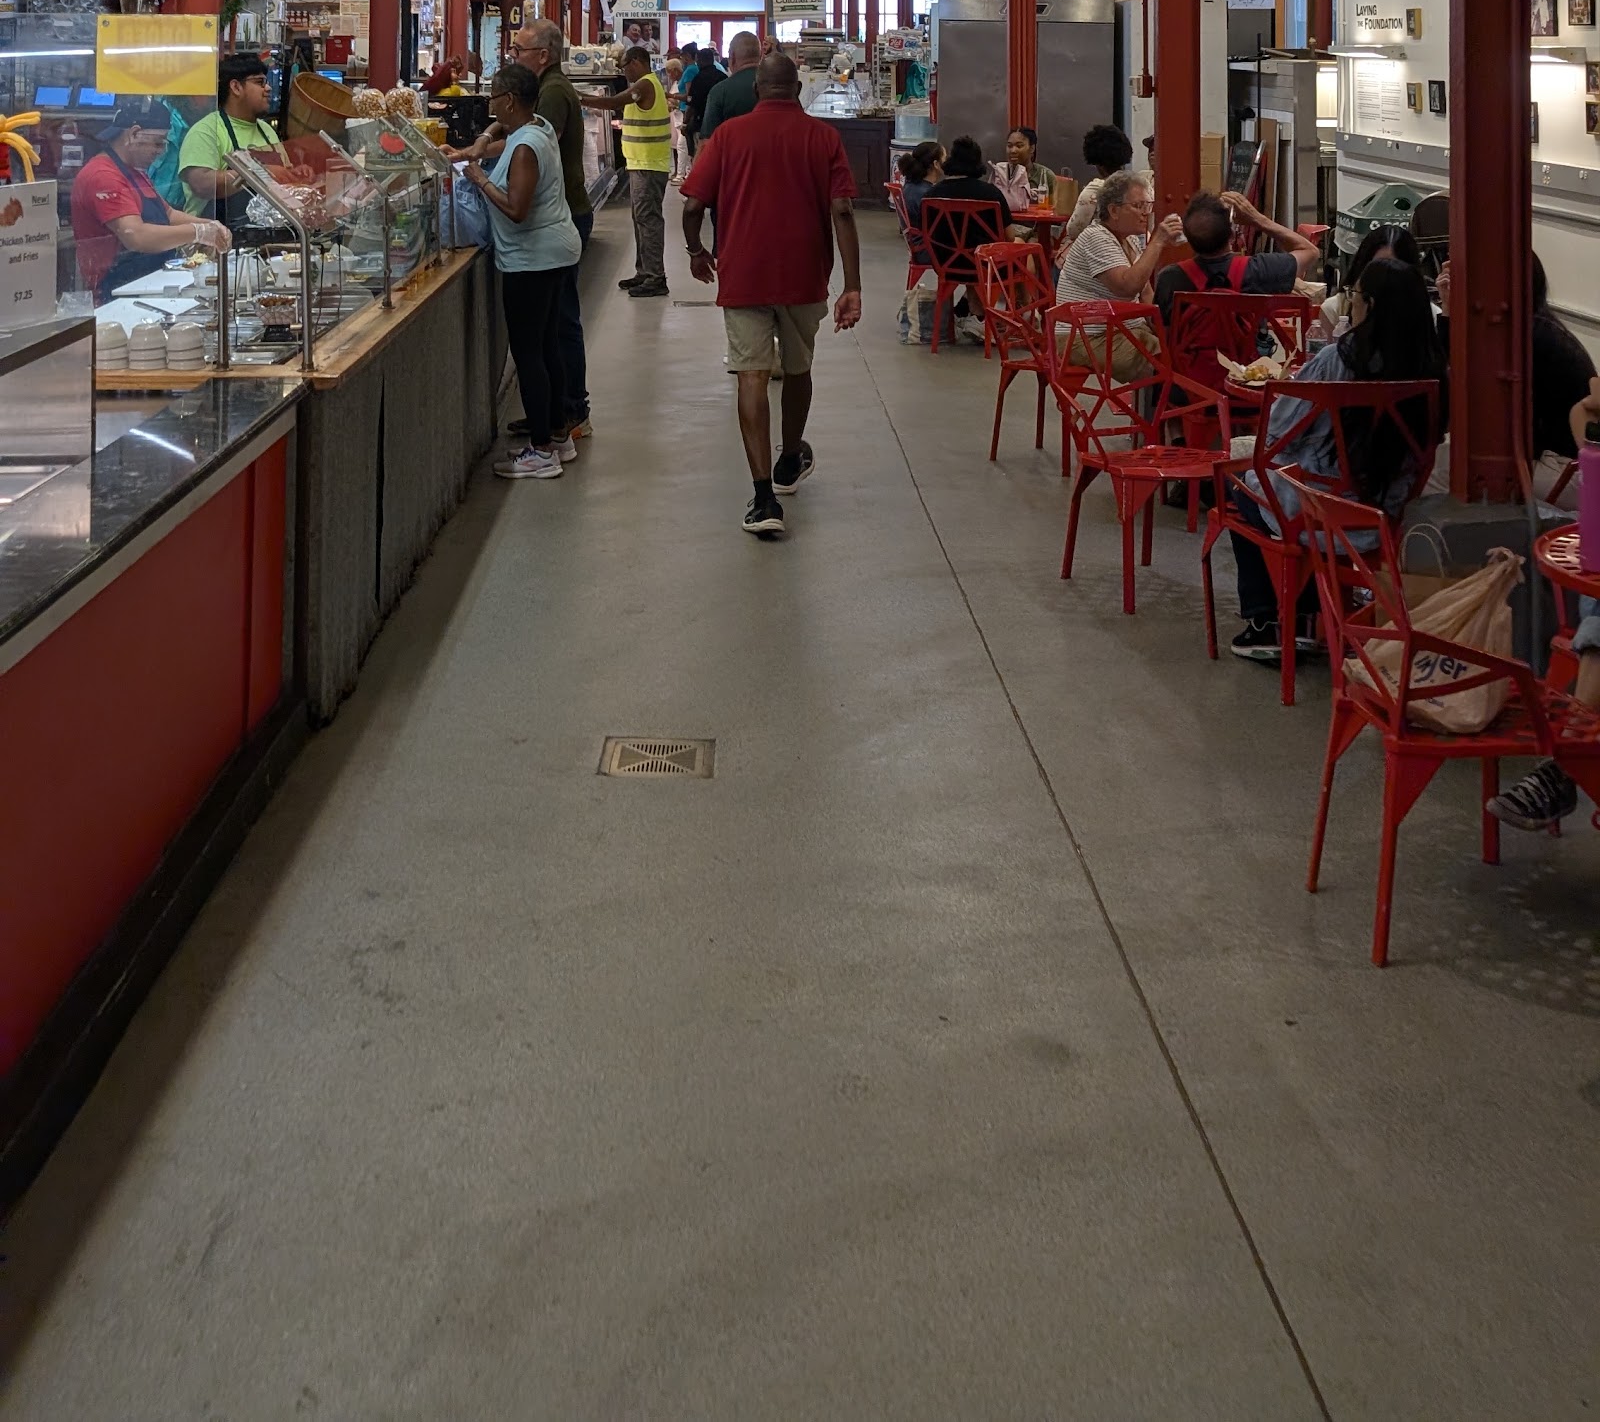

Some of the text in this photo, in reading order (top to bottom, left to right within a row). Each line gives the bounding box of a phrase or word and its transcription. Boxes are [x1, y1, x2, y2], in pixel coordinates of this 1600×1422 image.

[1364, 17, 1404, 29] FOUNDATION
[31, 193, 50, 206] New!
[25, 231, 51, 244] Tenders
[9, 251, 39, 264] and Fries
[14, 289, 33, 302] $7.25
